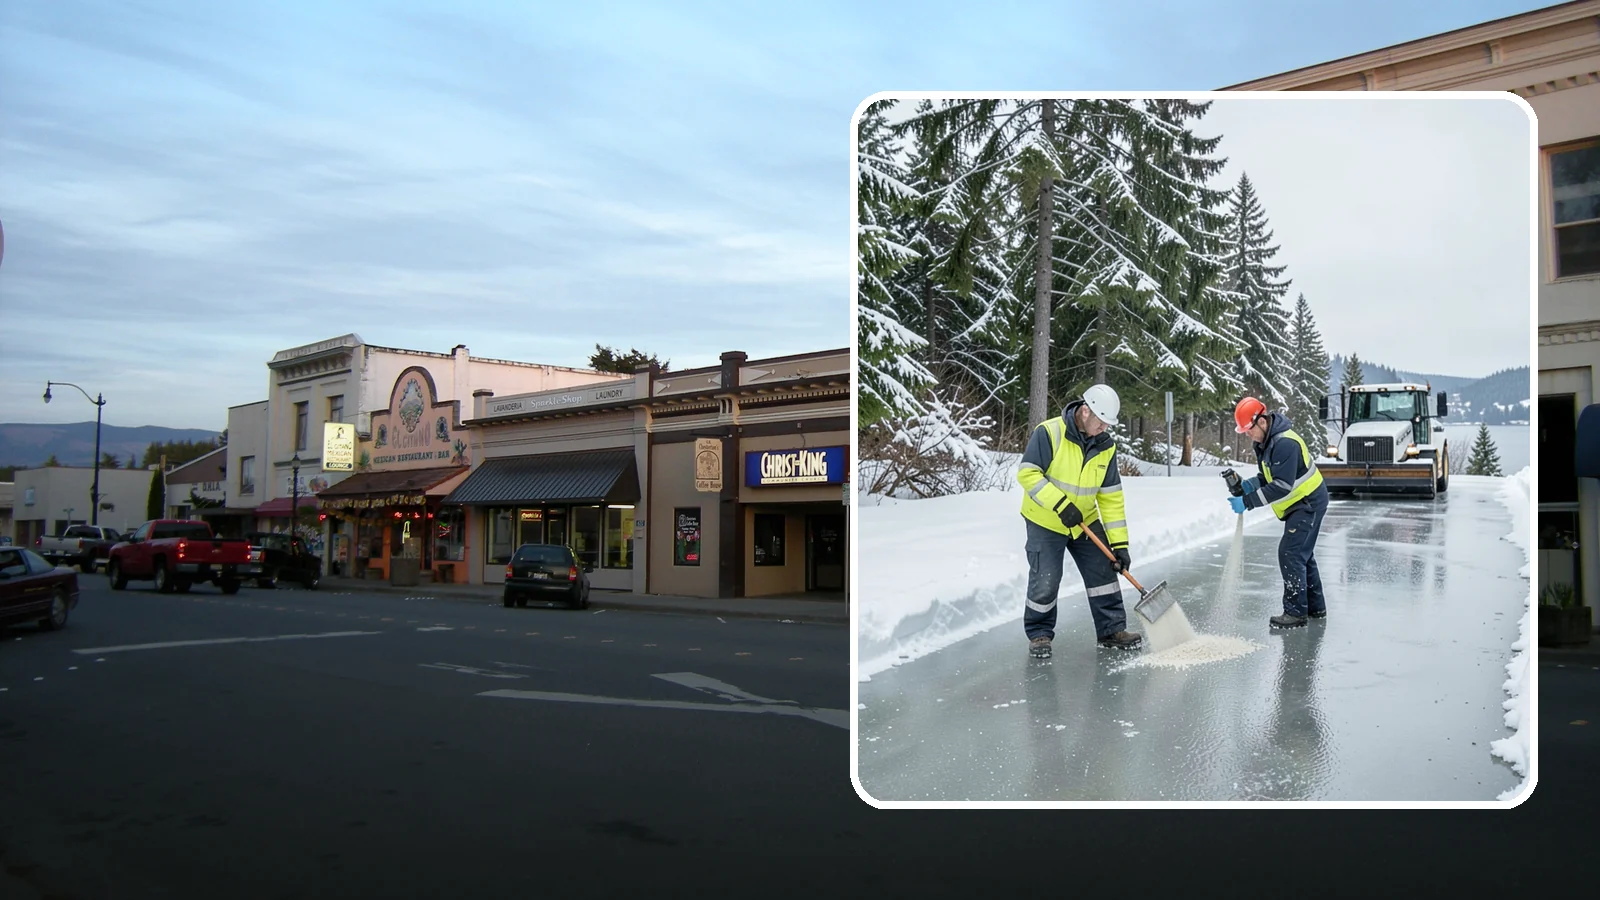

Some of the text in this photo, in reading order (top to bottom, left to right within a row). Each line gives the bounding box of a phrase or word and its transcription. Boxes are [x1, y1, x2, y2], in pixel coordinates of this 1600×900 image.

[530, 394, 582, 409] Sparkle Shop
[595, 389, 624, 400] LAUNDRY
[493, 402, 523, 412] LAVANDERIA
[392, 425, 401, 449] EL
[373, 455, 396, 464] MEXICAN
[397, 452, 433, 463] RESTAURANT
[438, 450, 450, 459] BAR
[761, 452, 797, 478] CHRIST
[799, 450, 827, 476] KING
[696, 481, 722, 489] Coffee House
